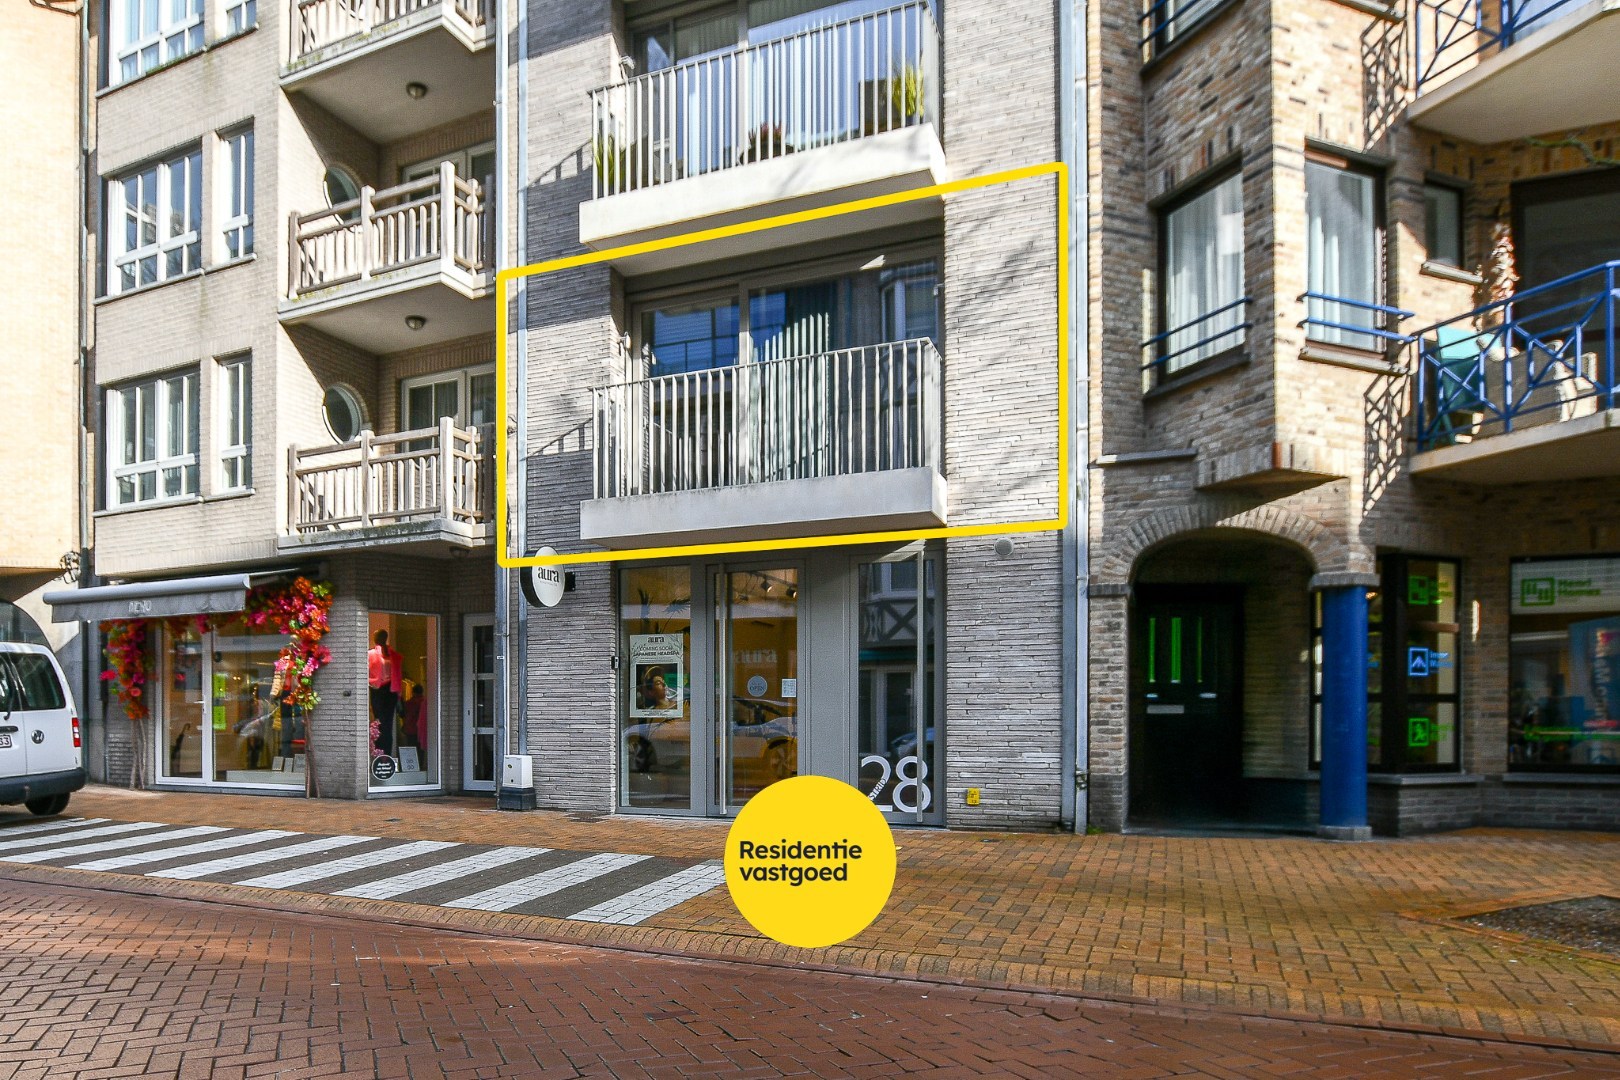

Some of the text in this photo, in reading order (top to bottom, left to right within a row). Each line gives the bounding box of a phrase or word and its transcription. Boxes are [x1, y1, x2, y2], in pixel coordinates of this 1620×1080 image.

[537, 566, 560, 583] aura
[861, 755, 931, 813] 28
[867, 778, 887, 801] STRID
